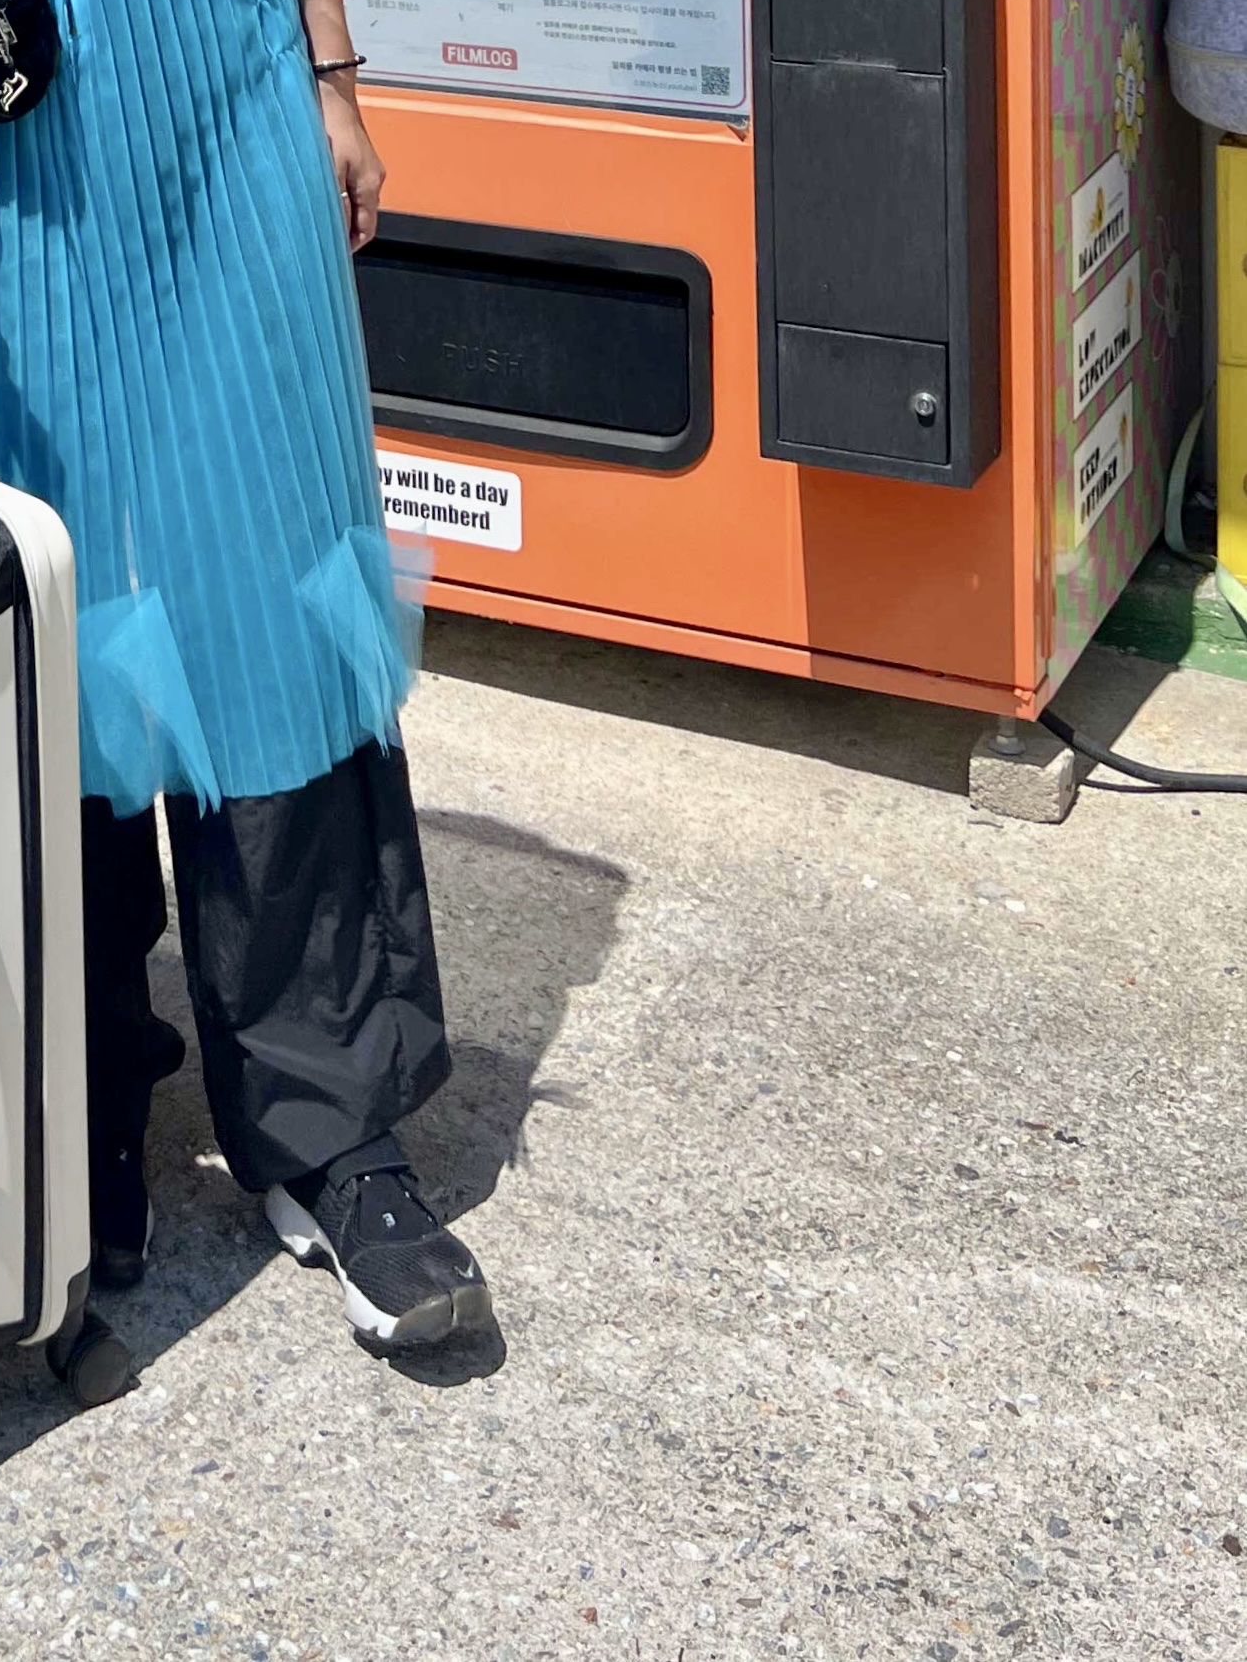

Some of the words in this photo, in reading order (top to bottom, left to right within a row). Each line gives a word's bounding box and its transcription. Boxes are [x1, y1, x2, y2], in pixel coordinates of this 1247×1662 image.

[447, 45, 513, 67] FILMLOG
[442, 342, 525, 377] PUSH
[397, 469, 428, 491] will
[434, 473, 455, 495] be
[461, 481, 471, 498] a
[476, 481, 508, 506] day
[384, 496, 490, 530] rememberd
